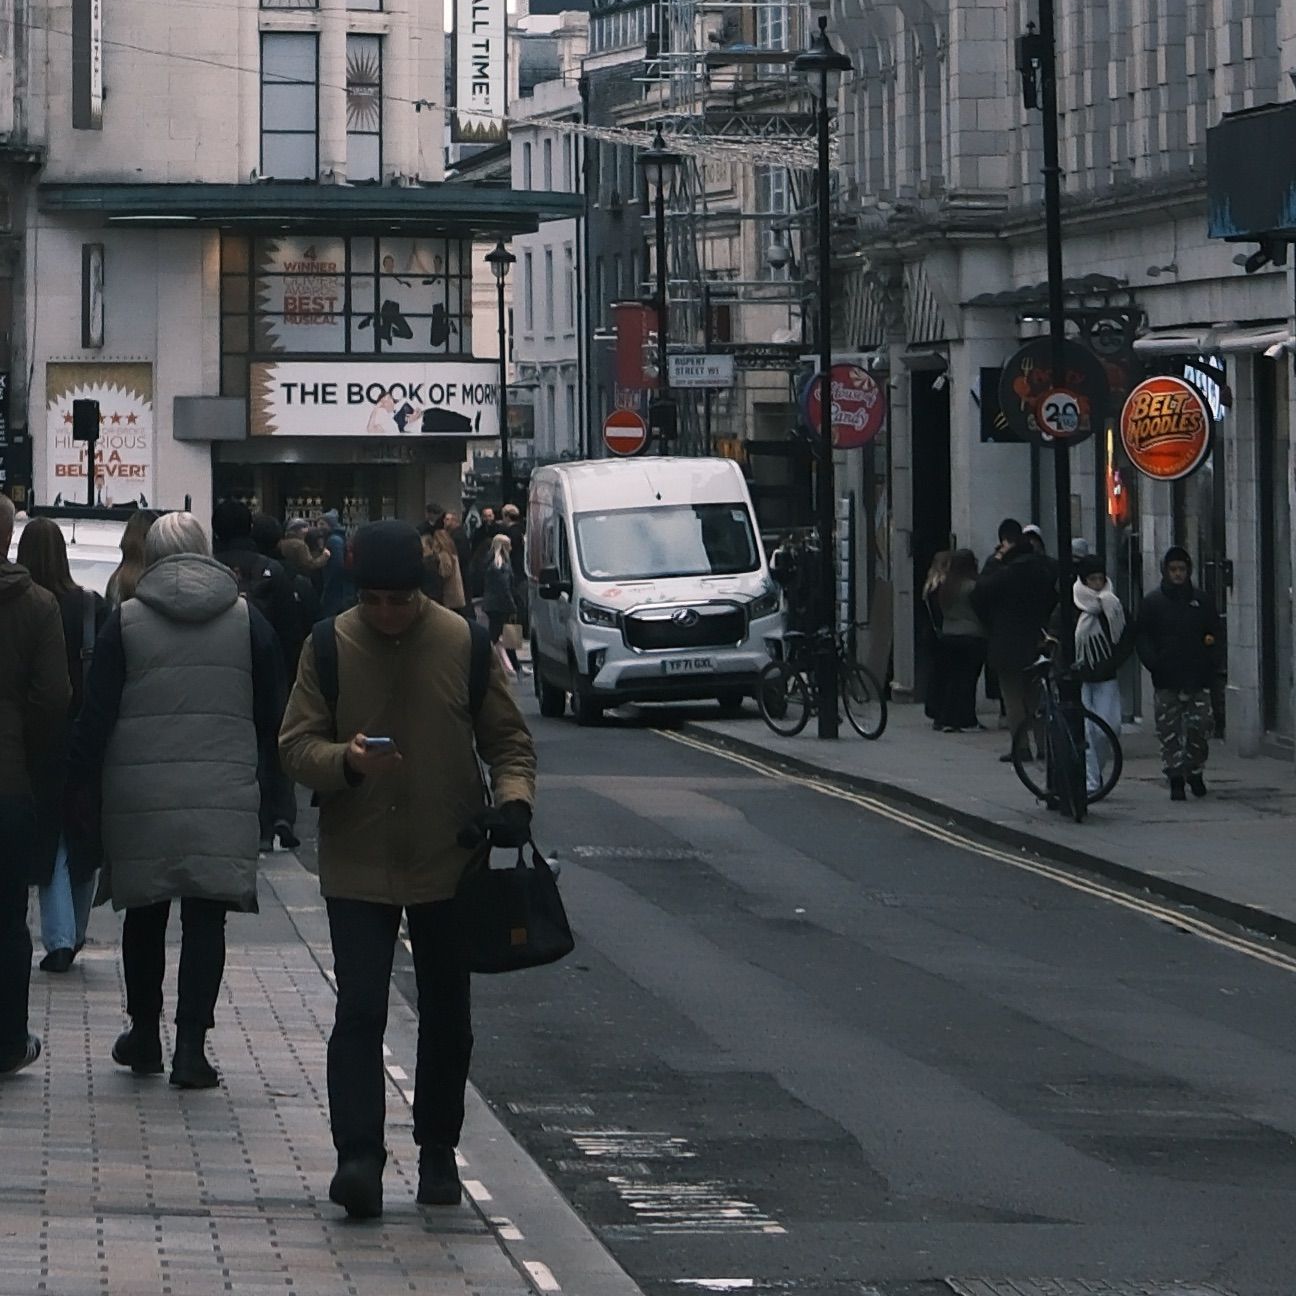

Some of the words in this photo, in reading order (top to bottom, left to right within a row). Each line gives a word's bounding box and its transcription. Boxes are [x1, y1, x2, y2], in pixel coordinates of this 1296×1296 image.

[283, 262, 337, 273] WINNER
[283, 296, 338, 313] BEST
[280, 383, 337, 405] THE
[347, 383, 424, 405] BOOK
[429, 383, 456, 405] OF
[1131, 391, 1190, 418] BELT
[1127, 411, 1204, 446] NOODLES
[109, 450, 121, 463] A
